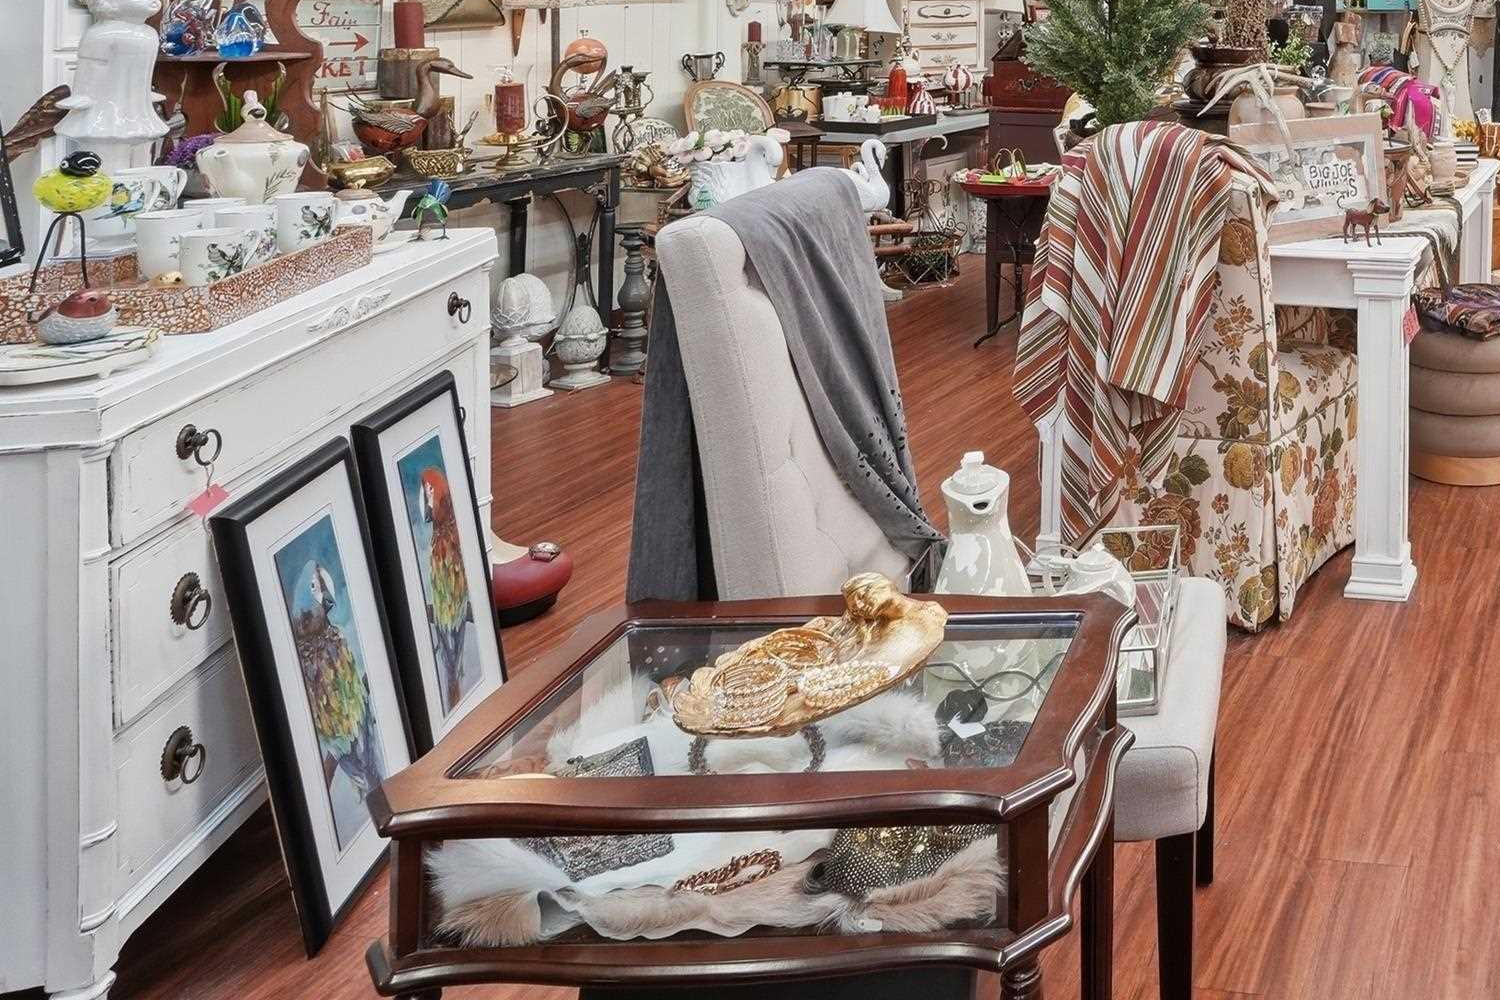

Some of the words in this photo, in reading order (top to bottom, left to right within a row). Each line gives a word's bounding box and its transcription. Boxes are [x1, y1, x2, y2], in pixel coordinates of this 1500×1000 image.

[314, 55, 369, 79] KET
[1309, 165, 1330, 180] BIG
[1332, 163, 1353, 180] JOE
